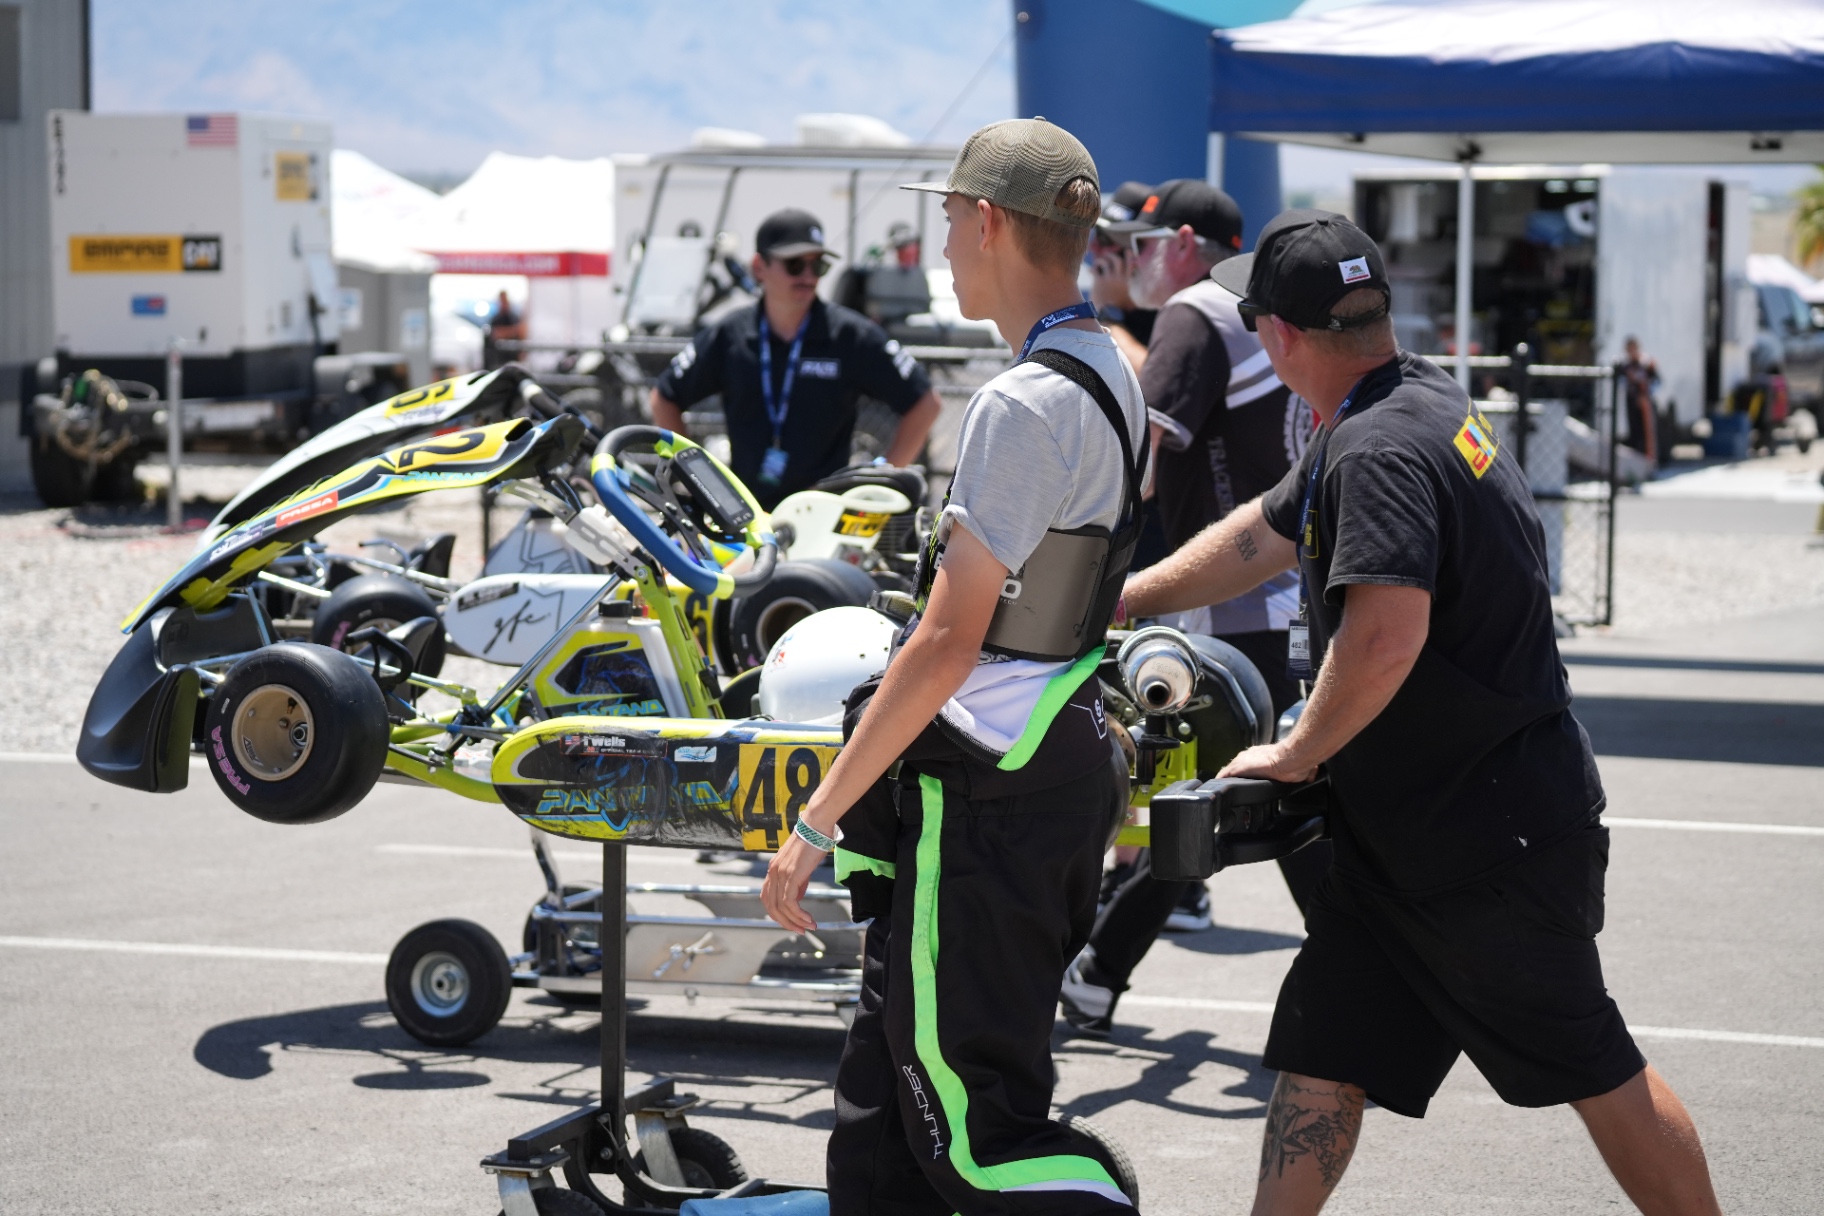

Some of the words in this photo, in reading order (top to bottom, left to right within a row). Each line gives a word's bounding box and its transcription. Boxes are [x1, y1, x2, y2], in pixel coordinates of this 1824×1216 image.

[561, 699, 666, 716] NTANO
[742, 747, 841, 849] 48
[902, 1064, 944, 1160] THUNDER
